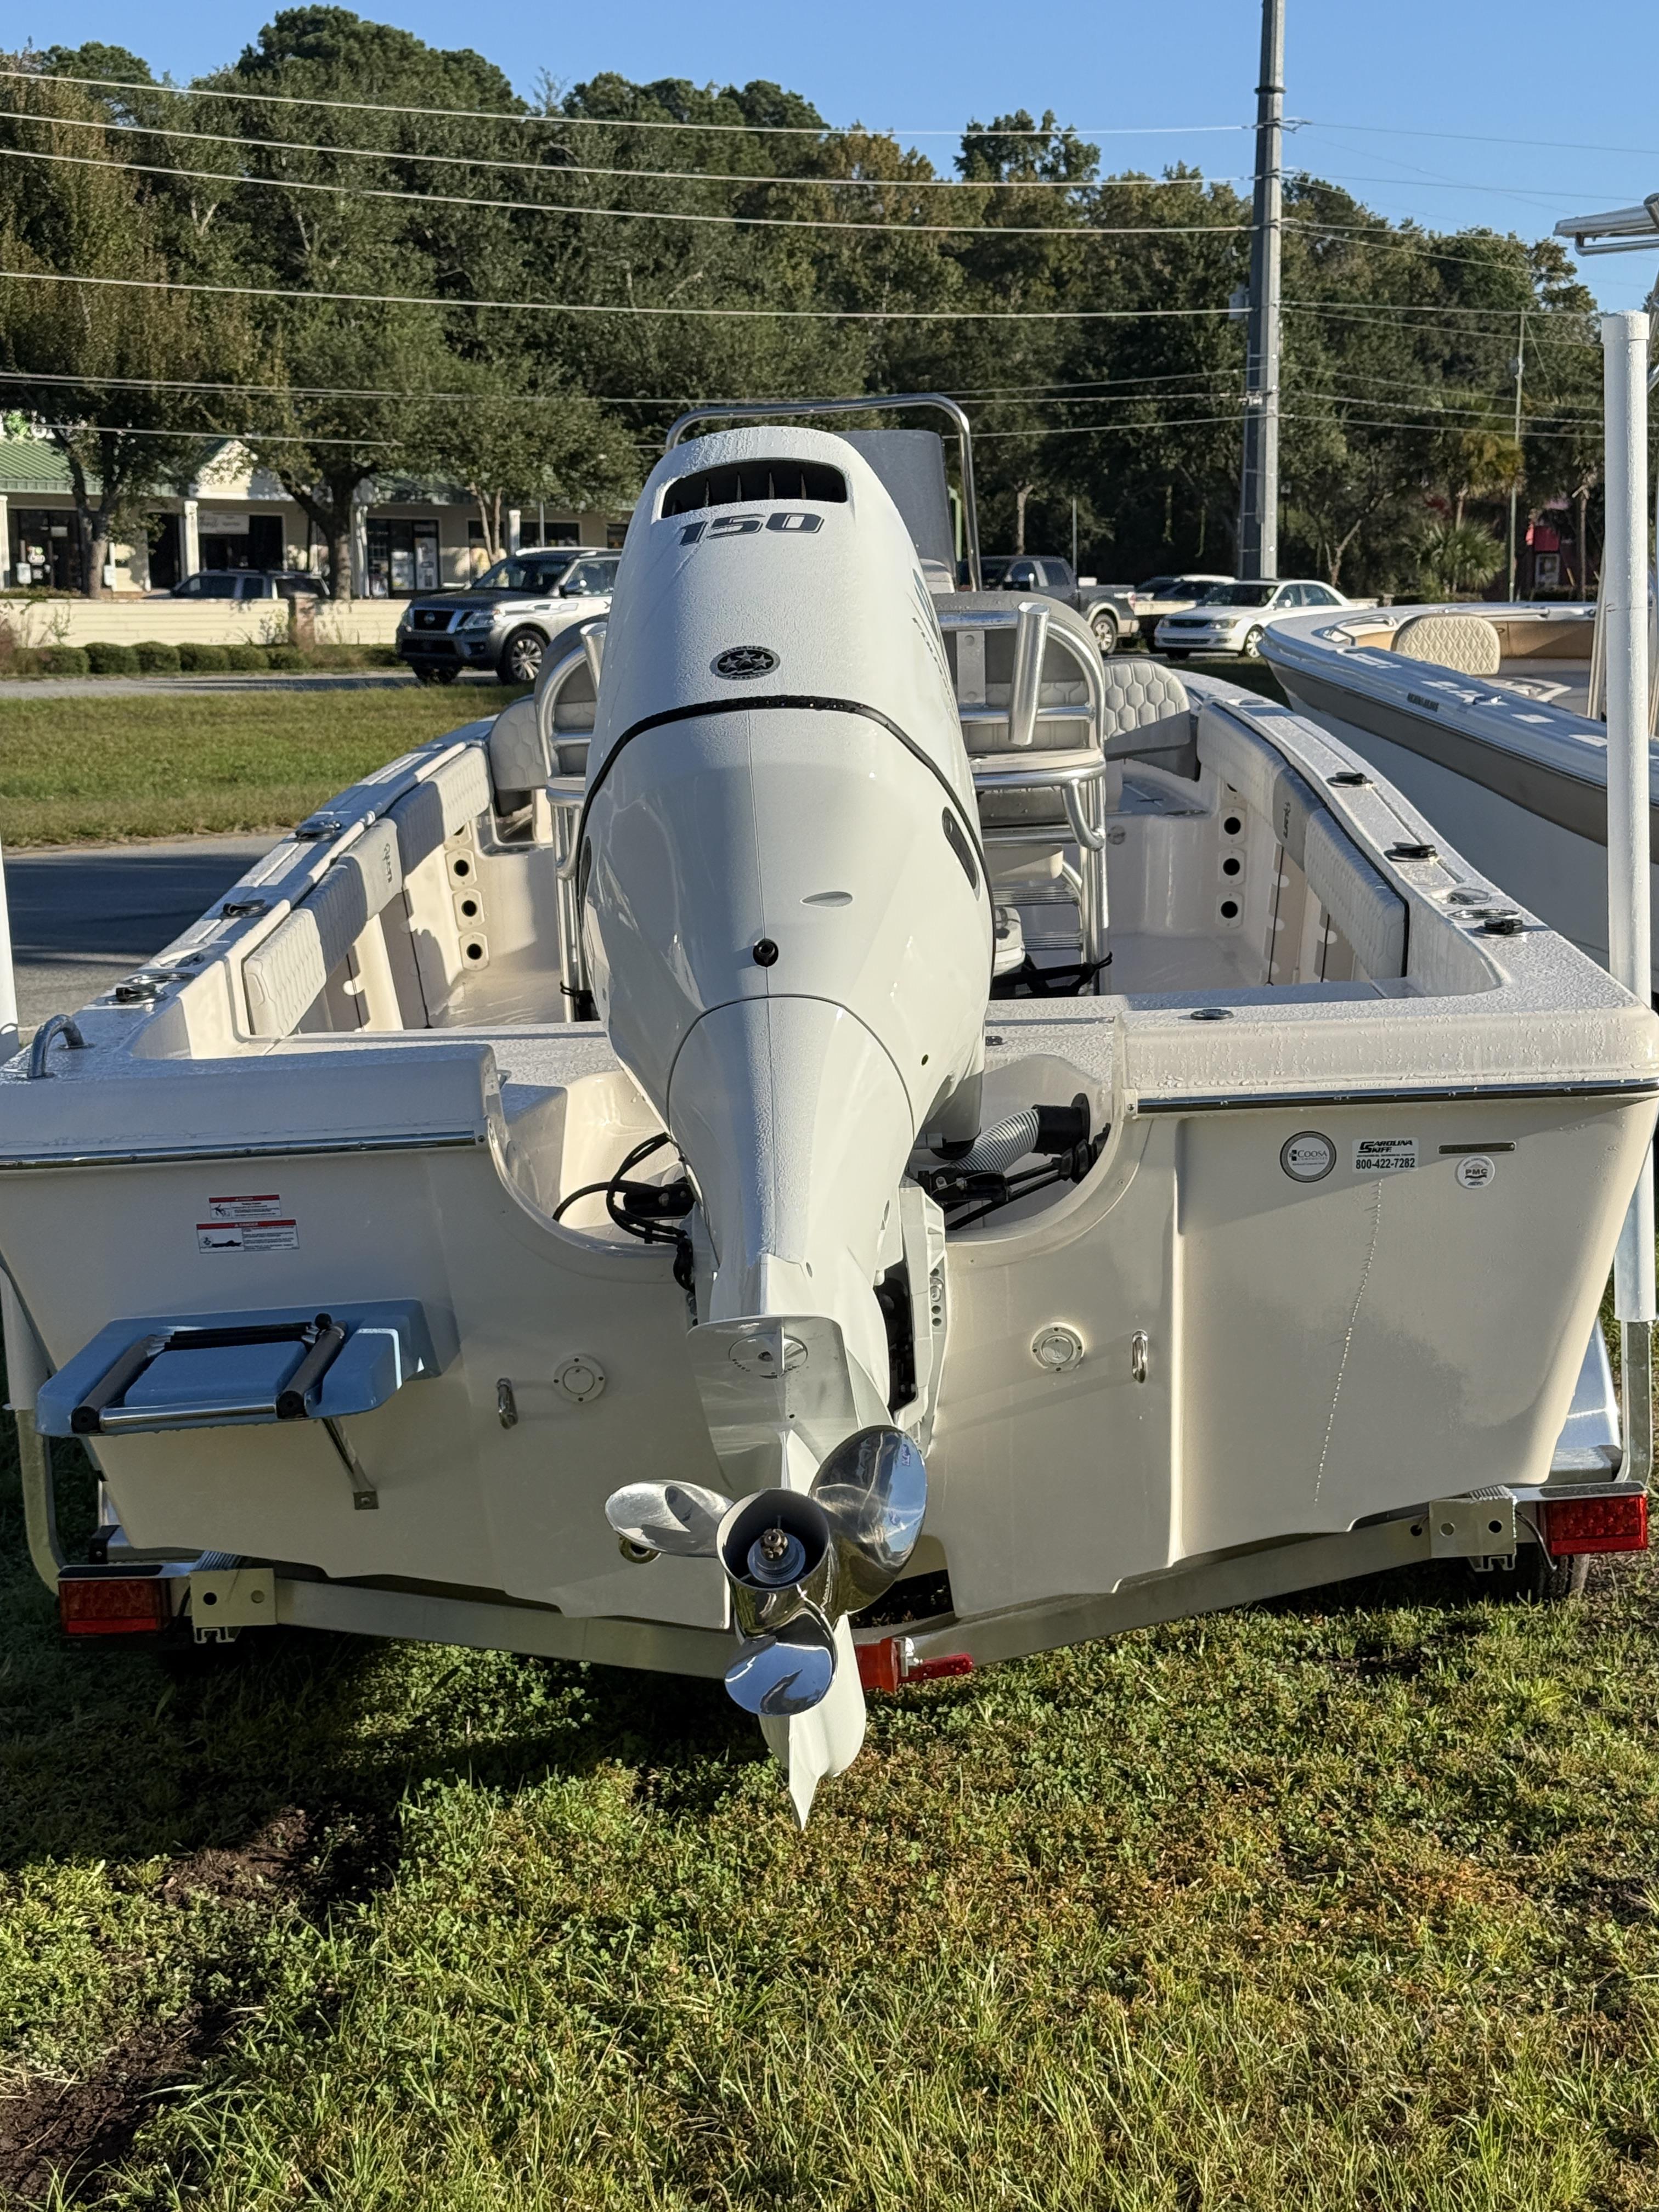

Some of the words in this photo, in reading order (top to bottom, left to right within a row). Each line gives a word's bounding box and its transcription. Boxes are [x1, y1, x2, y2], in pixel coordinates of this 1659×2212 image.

[679, 512, 825, 546] 150
[1297, 1149, 1328, 1158] COOSA
[1356, 1158, 1415, 1169] 800-422-7282
